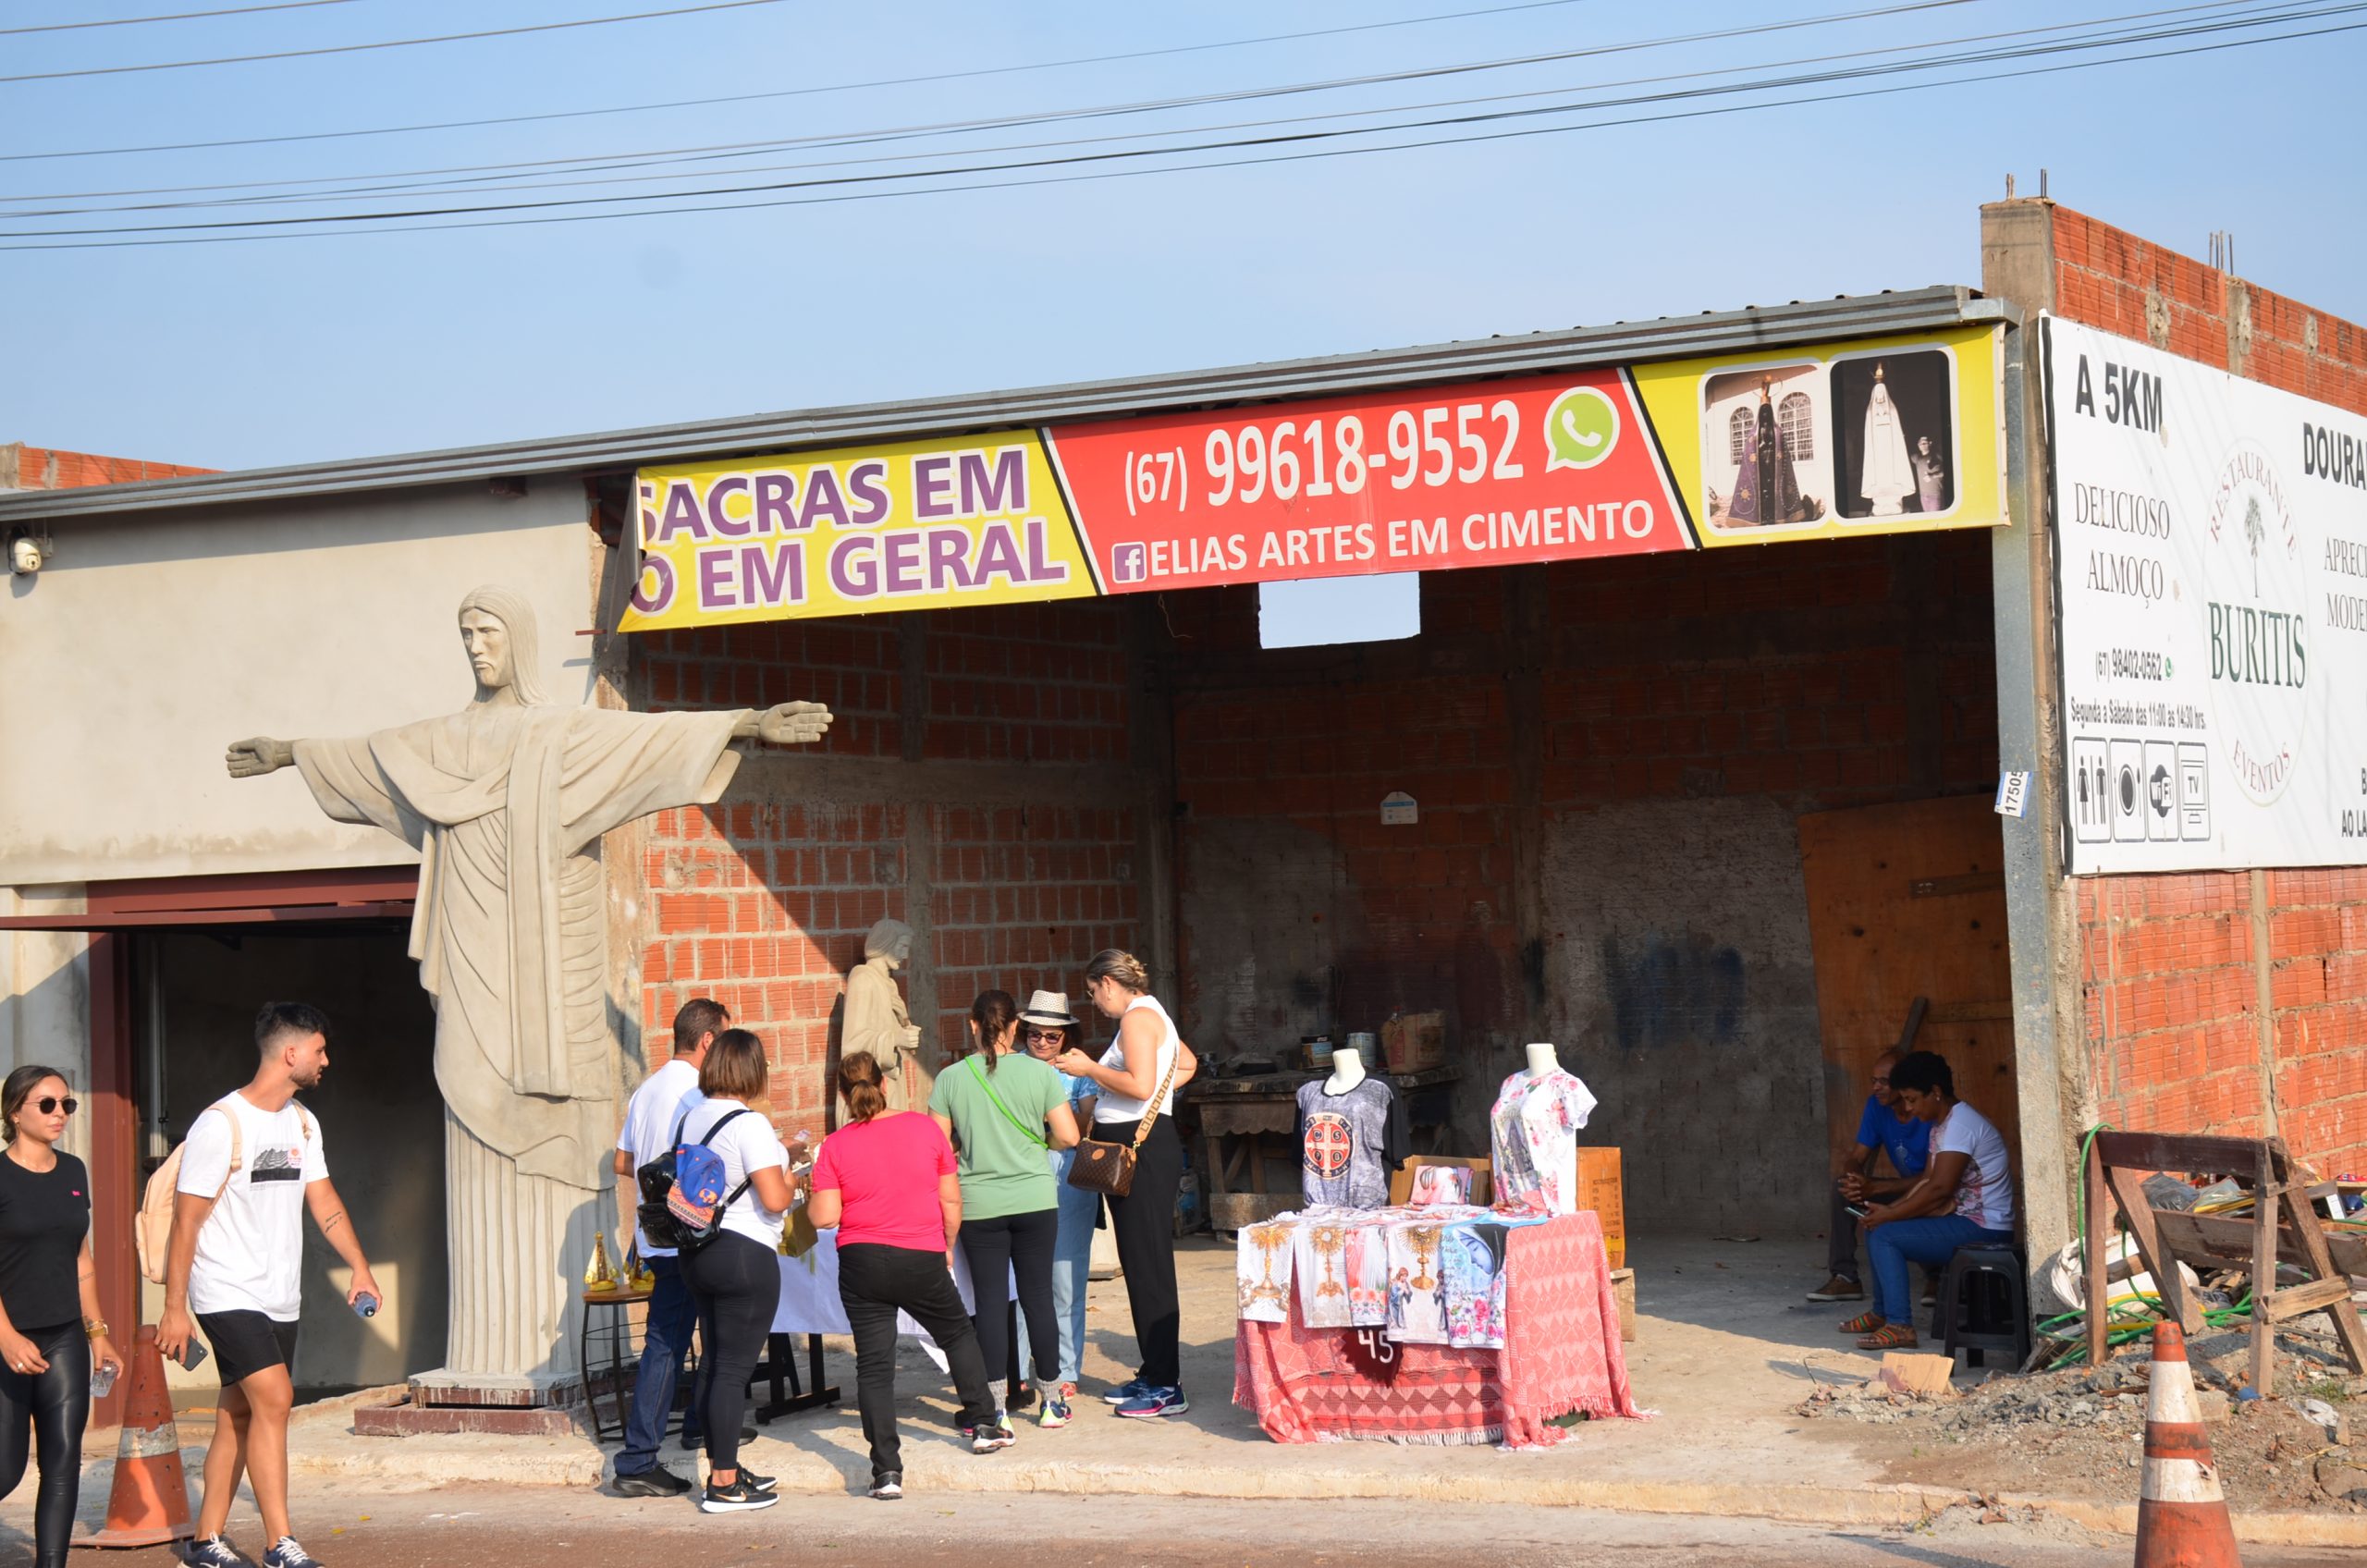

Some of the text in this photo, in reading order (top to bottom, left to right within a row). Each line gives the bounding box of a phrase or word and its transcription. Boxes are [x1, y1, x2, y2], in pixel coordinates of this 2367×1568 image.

[2074, 352, 2164, 435] A 5KM
[914, 448, 1026, 518] EM
[1124, 398, 1525, 517] (67) 99618-9552
[2302, 421, 2367, 492] DOURA
[2073, 481, 2171, 541] DELICIOSO
[2210, 450, 2298, 561] RESTAURANTE
[698, 544, 805, 609] EM
[830, 521, 1066, 599] GERAL
[1150, 533, 1248, 577] ELIAS
[1257, 522, 1377, 569] ARTES
[1387, 517, 1450, 557] EM
[1461, 499, 1655, 552] CIMENTO
[2324, 537, 2367, 579] APREC
[2086, 548, 2165, 610] ALMOÇO
[2326, 592, 2367, 633] MODE
[2095, 647, 2162, 683] (67) 98402-0562
[2207, 601, 2306, 690] BURITIS
[2070, 695, 2102, 729] Segunda
[2103, 704, 2108, 724] a
[2136, 700, 2148, 727] das
[2149, 702, 2166, 728] 11:00
[2177, 704, 2193, 729] 14:30
[2188, 775, 2200, 794] TV
[2233, 738, 2291, 793] EVENTOS
[2341, 808, 2354, 838] AO
[1357, 1329, 1393, 1364] 45
